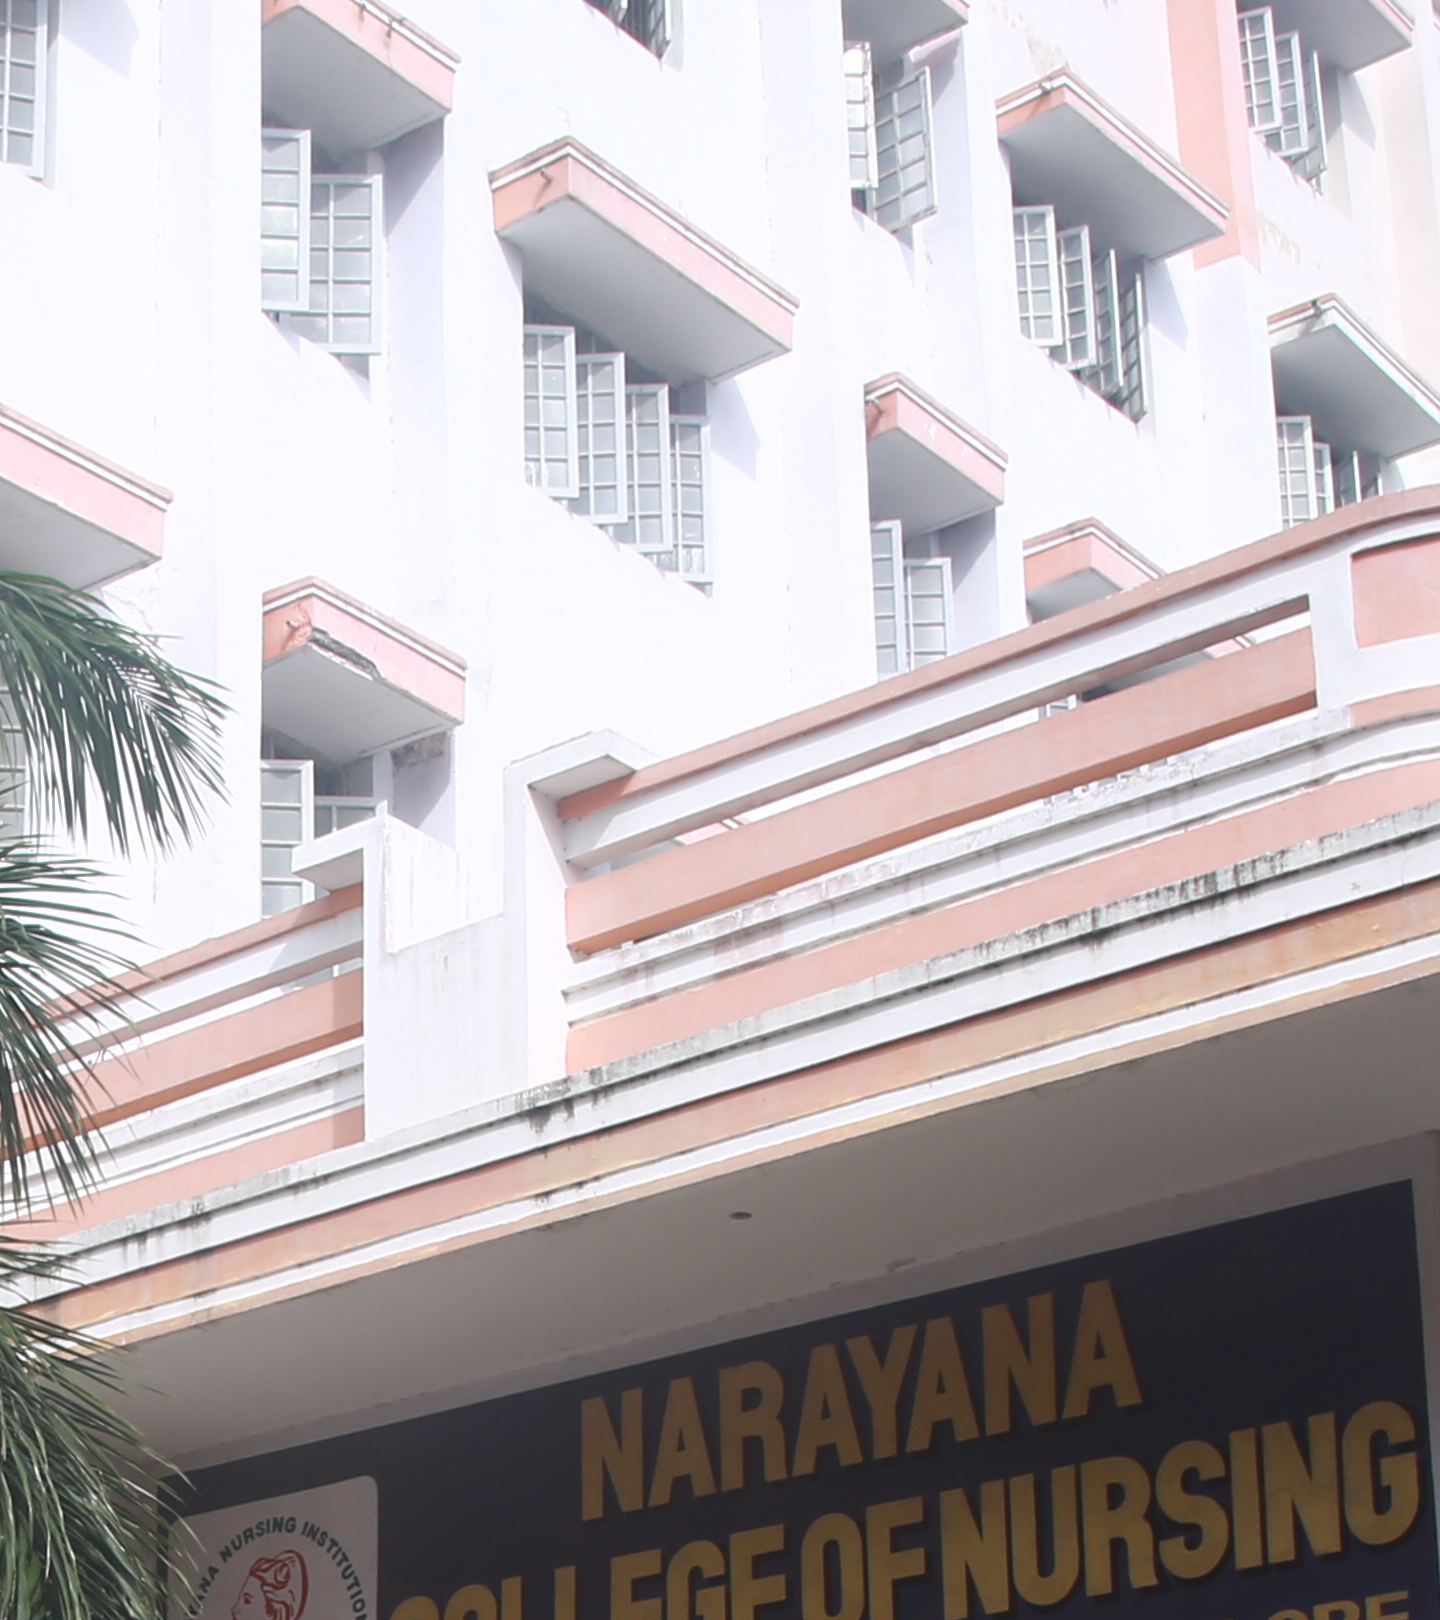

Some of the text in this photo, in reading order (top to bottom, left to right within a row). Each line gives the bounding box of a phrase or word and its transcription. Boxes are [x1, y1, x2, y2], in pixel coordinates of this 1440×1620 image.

[581, 1280, 1142, 1521] NARAYANA
[939, 1400, 1420, 1620] NURSING
[220, 1516, 298, 1563] NURSING
